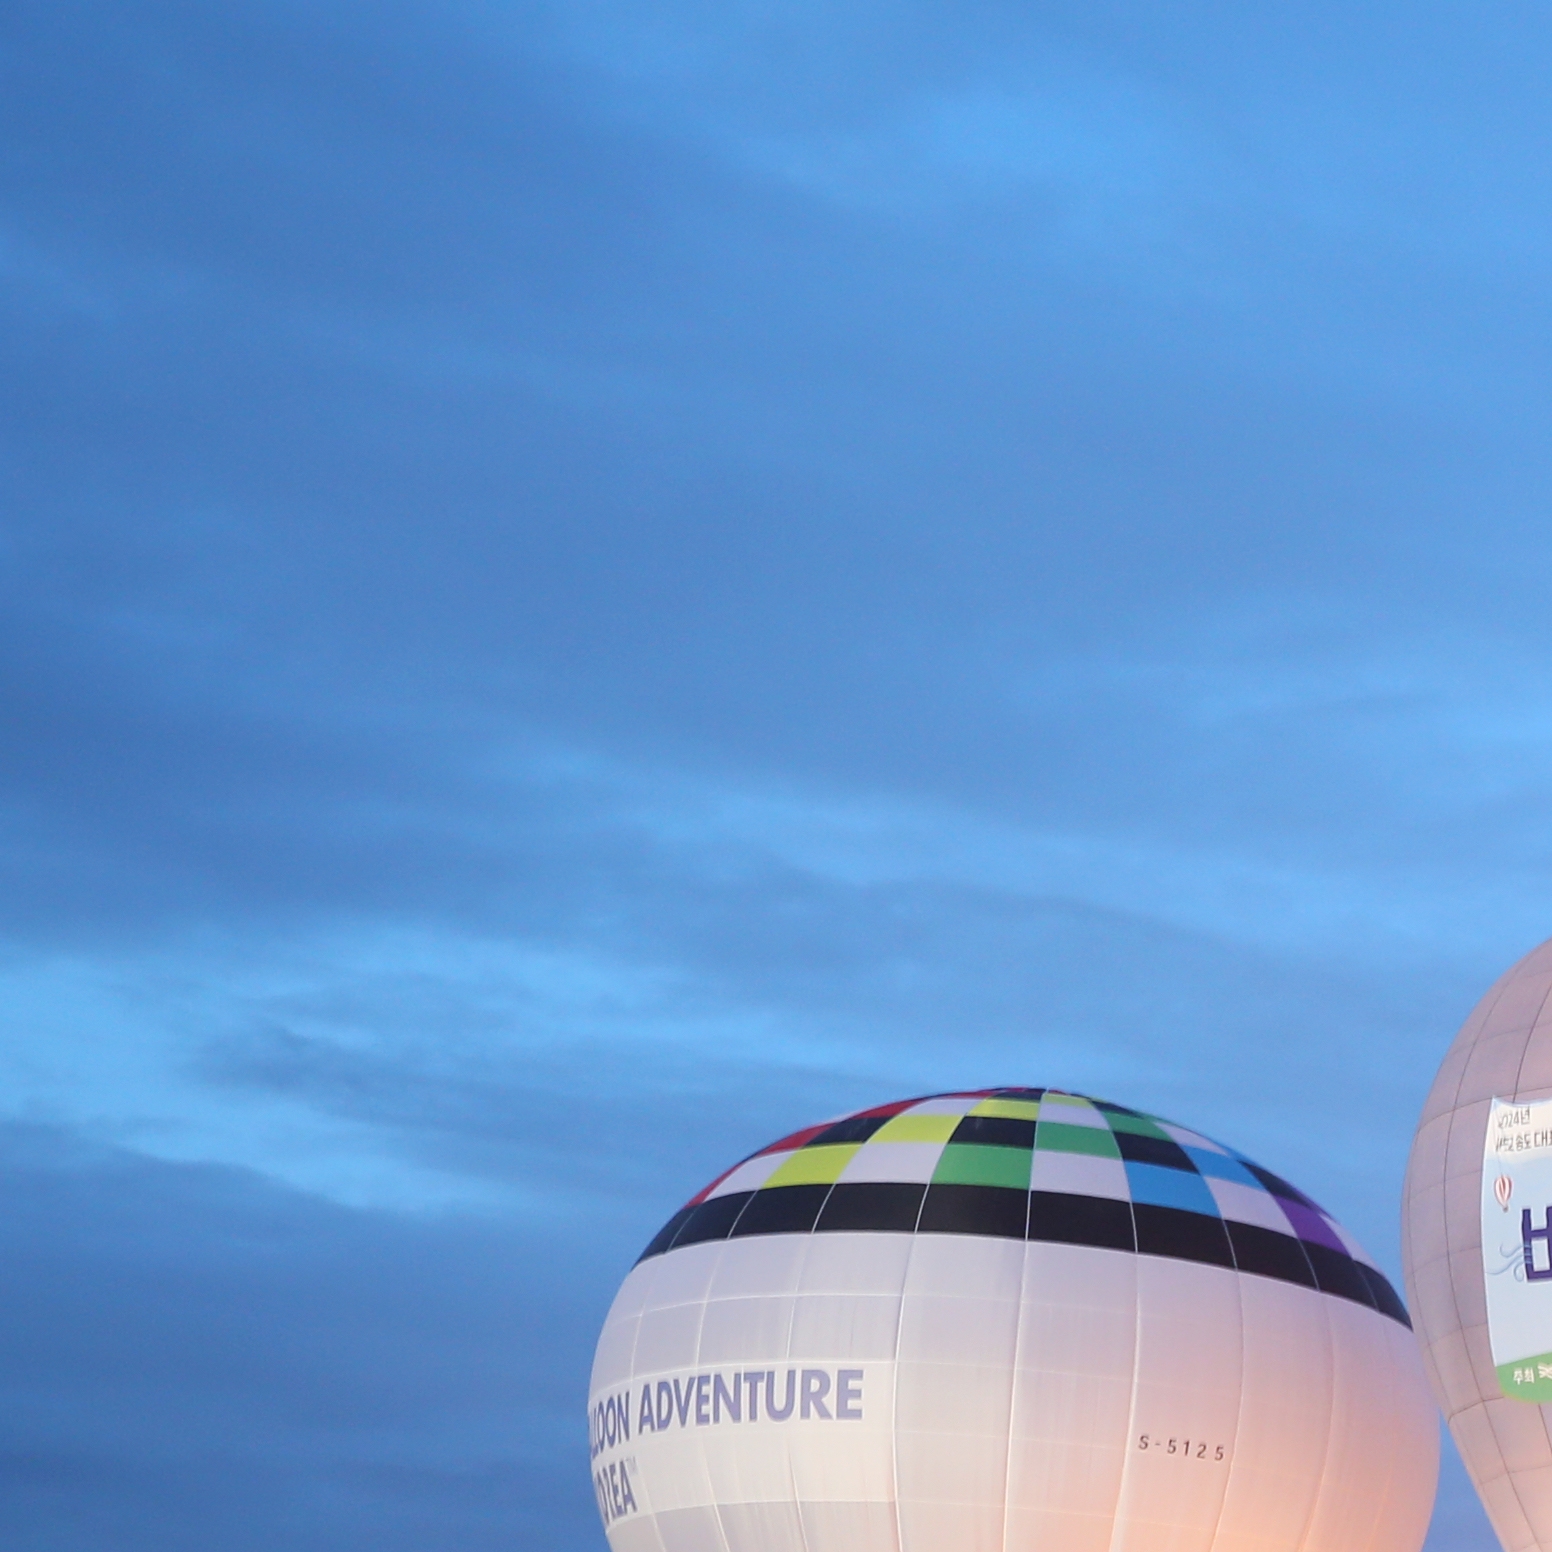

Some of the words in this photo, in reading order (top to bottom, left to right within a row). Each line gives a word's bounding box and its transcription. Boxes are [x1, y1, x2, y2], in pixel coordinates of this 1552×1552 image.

[1514, 1368, 1534, 1385] 주최
[638, 1369, 864, 1435] ADVENTURE
[1138, 1435, 1224, 1461] S-5125
